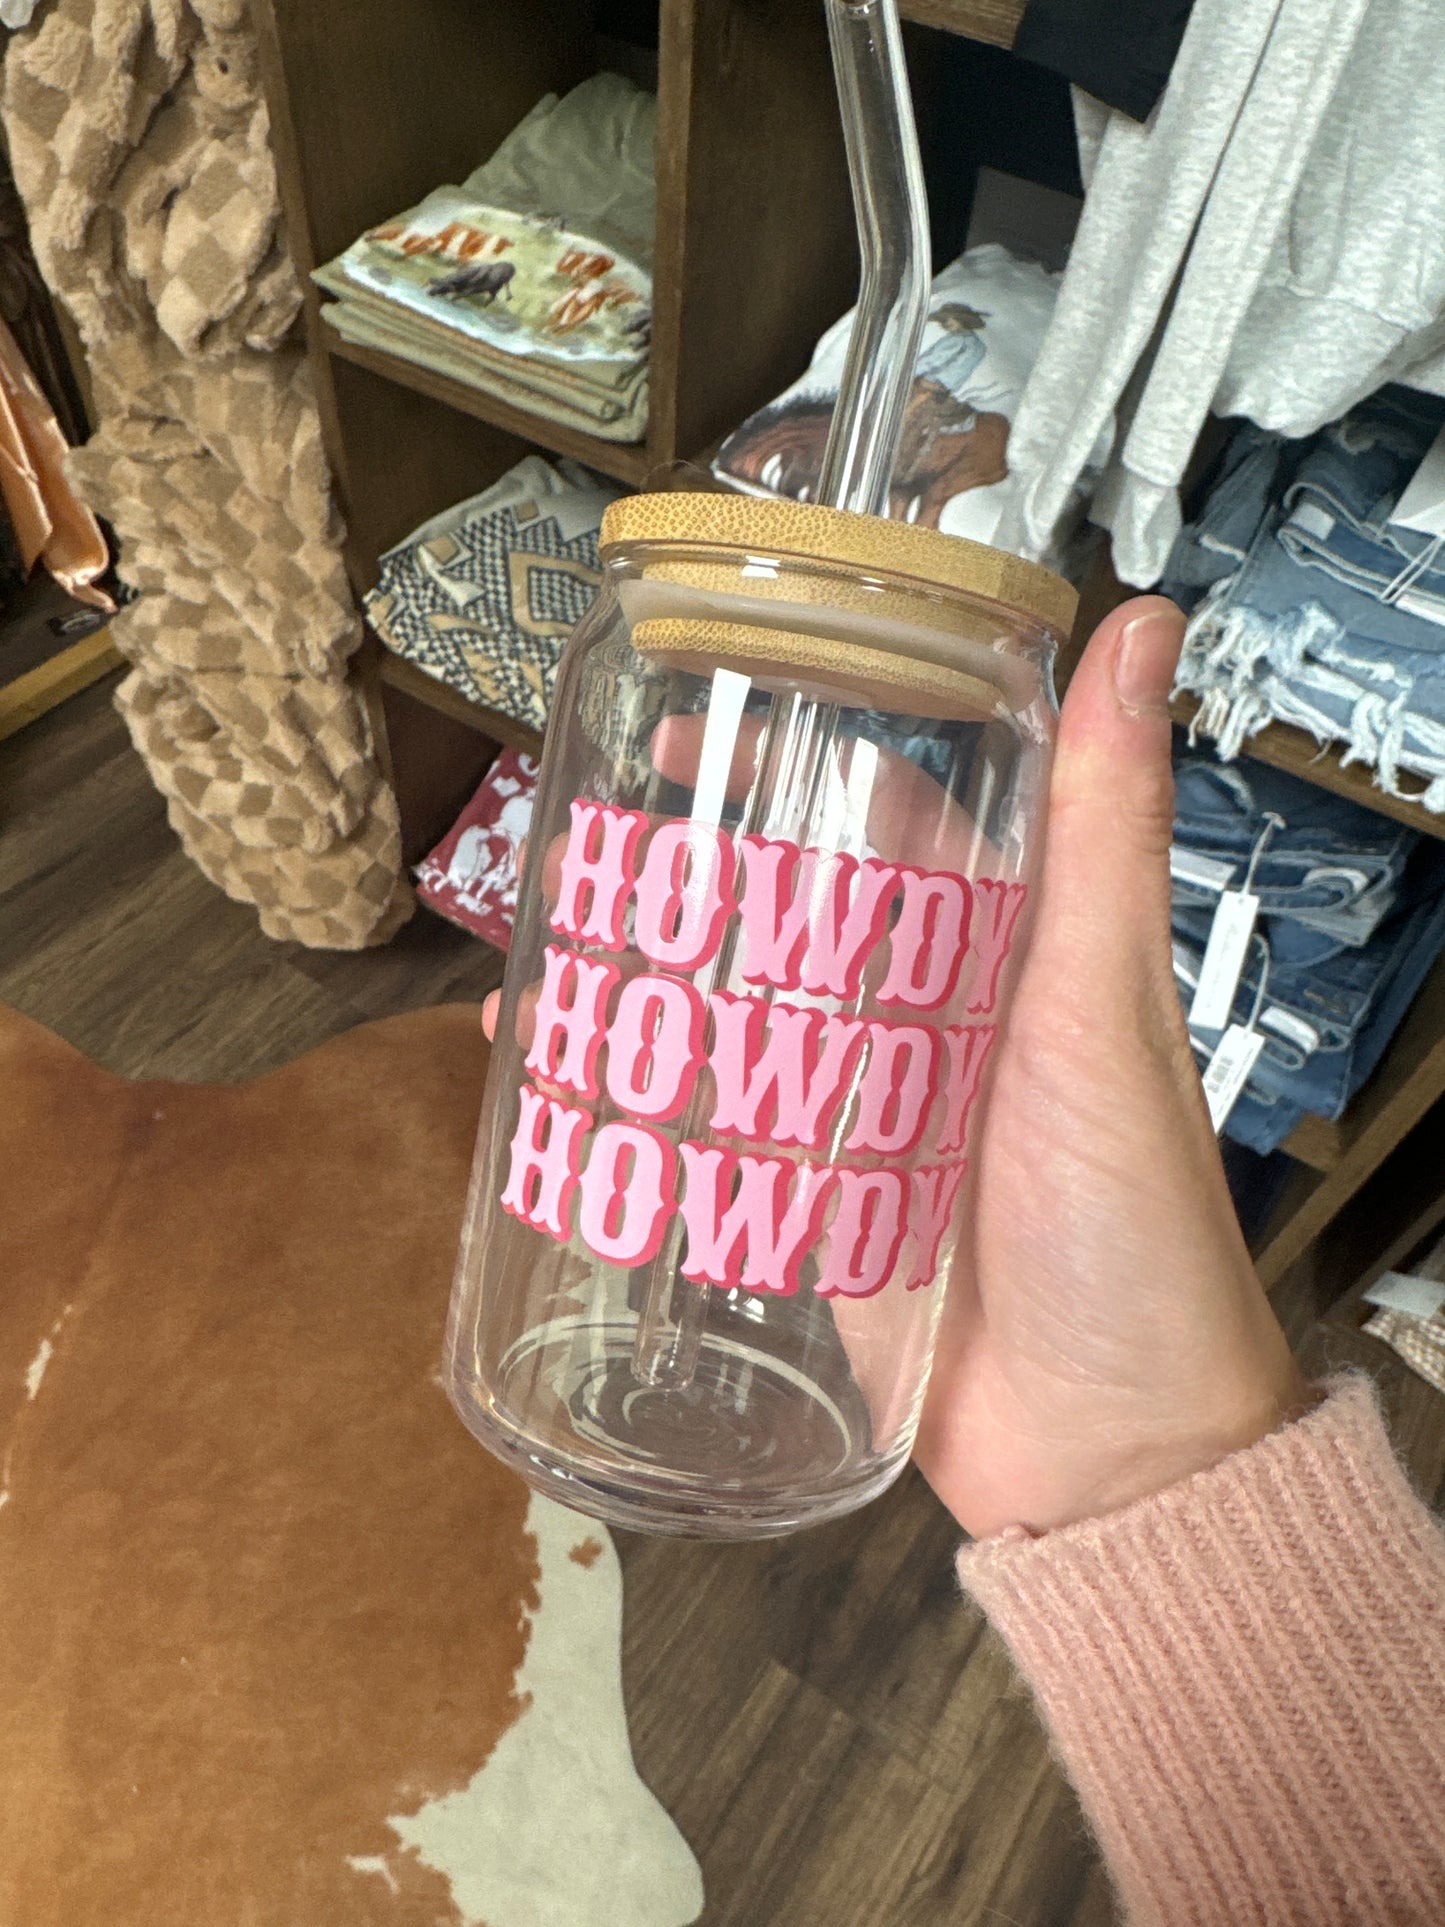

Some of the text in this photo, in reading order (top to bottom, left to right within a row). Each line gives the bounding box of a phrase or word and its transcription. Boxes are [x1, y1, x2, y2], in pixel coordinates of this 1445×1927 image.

[550, 799, 1027, 1013] HOWDY
[525, 944, 997, 1155] HOWDY
[501, 1084, 967, 1299] HOWDY
